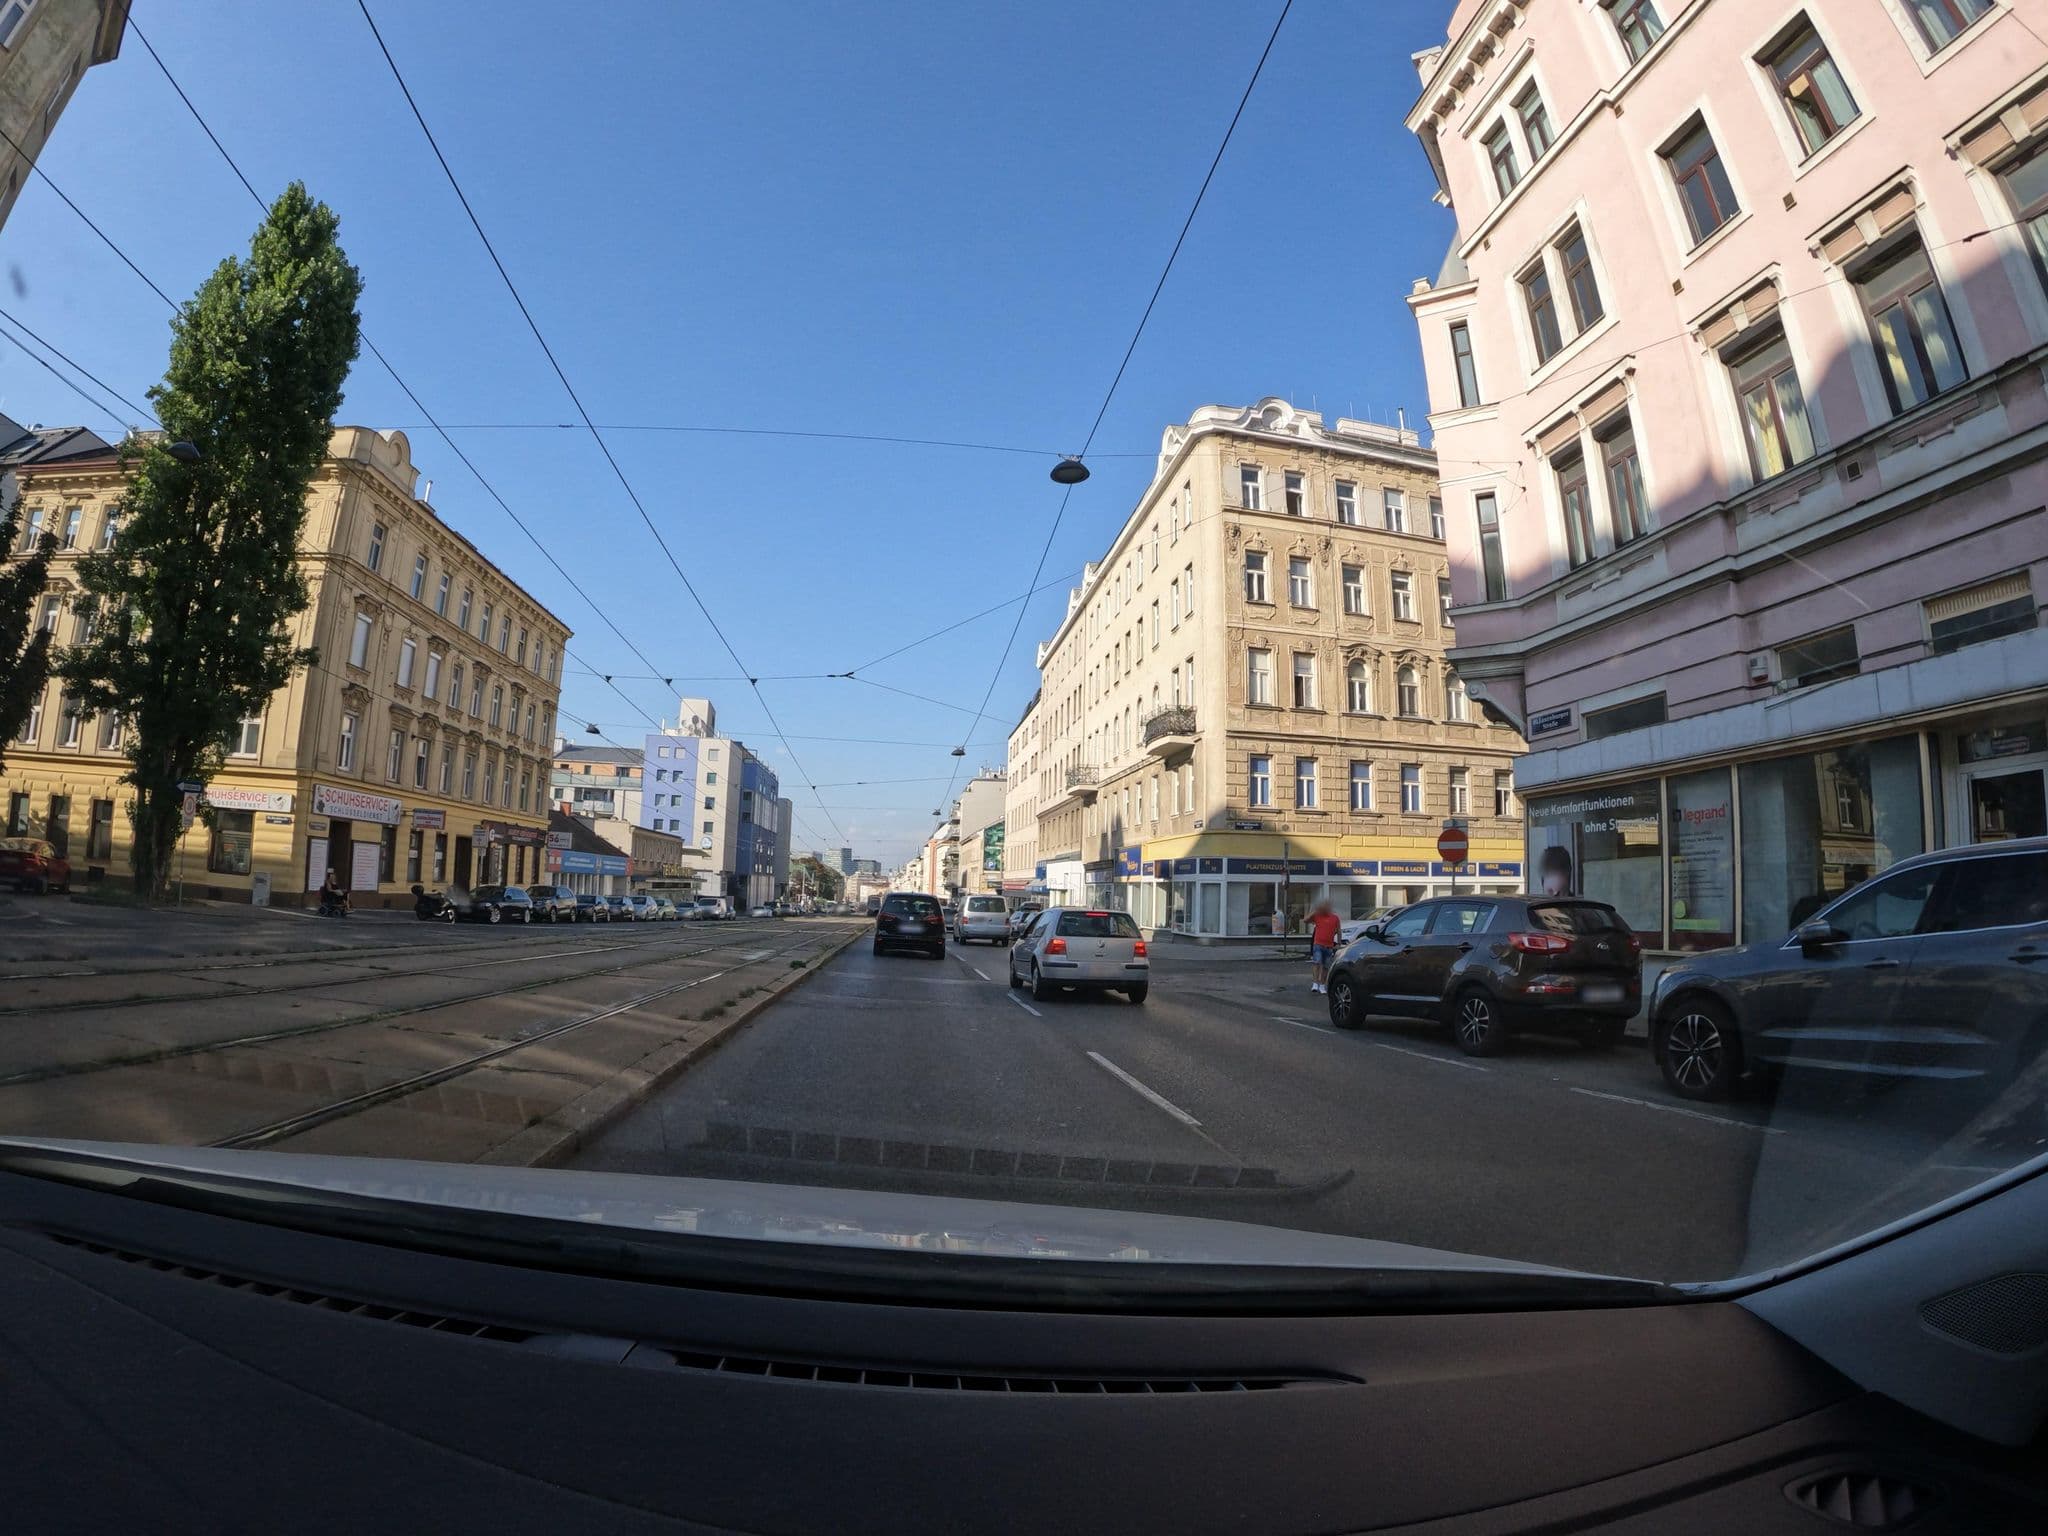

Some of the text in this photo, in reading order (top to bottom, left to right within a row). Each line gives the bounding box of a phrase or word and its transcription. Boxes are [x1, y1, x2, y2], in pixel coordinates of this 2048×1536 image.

[205, 790, 268, 803] HUHSERVICE
[325, 789, 389, 812] SCHUHSERVICE
[1528, 795, 1635, 818] Neue Komfortfunktionen
[1683, 803, 1726, 825] legrand
[1584, 820, 1607, 833] ohne
